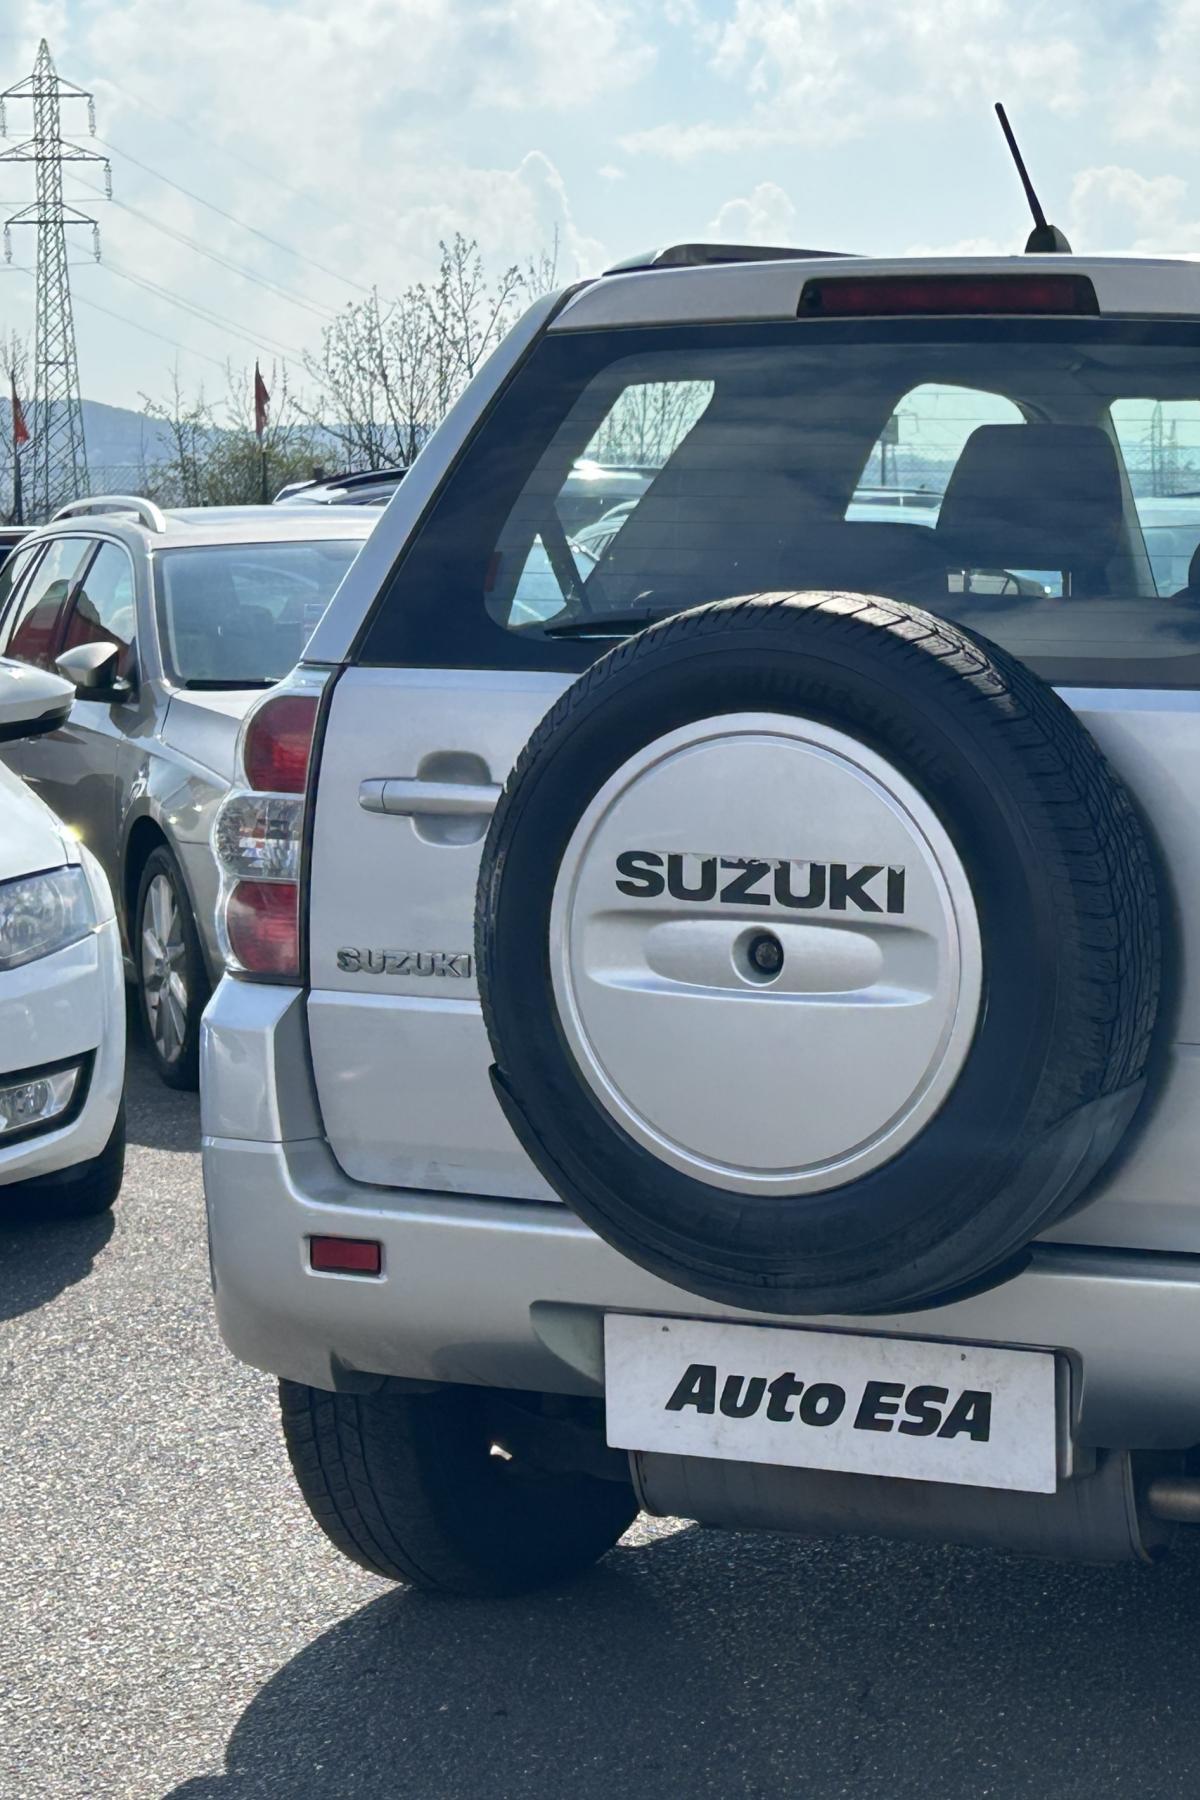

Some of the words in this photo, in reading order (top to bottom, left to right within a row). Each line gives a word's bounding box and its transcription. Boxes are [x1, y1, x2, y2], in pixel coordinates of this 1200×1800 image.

[615, 850, 905, 914] SUZUKI
[336, 946, 472, 978] SUZUKI
[664, 1363, 847, 1427] Auto
[853, 1380, 993, 1443] ESA
